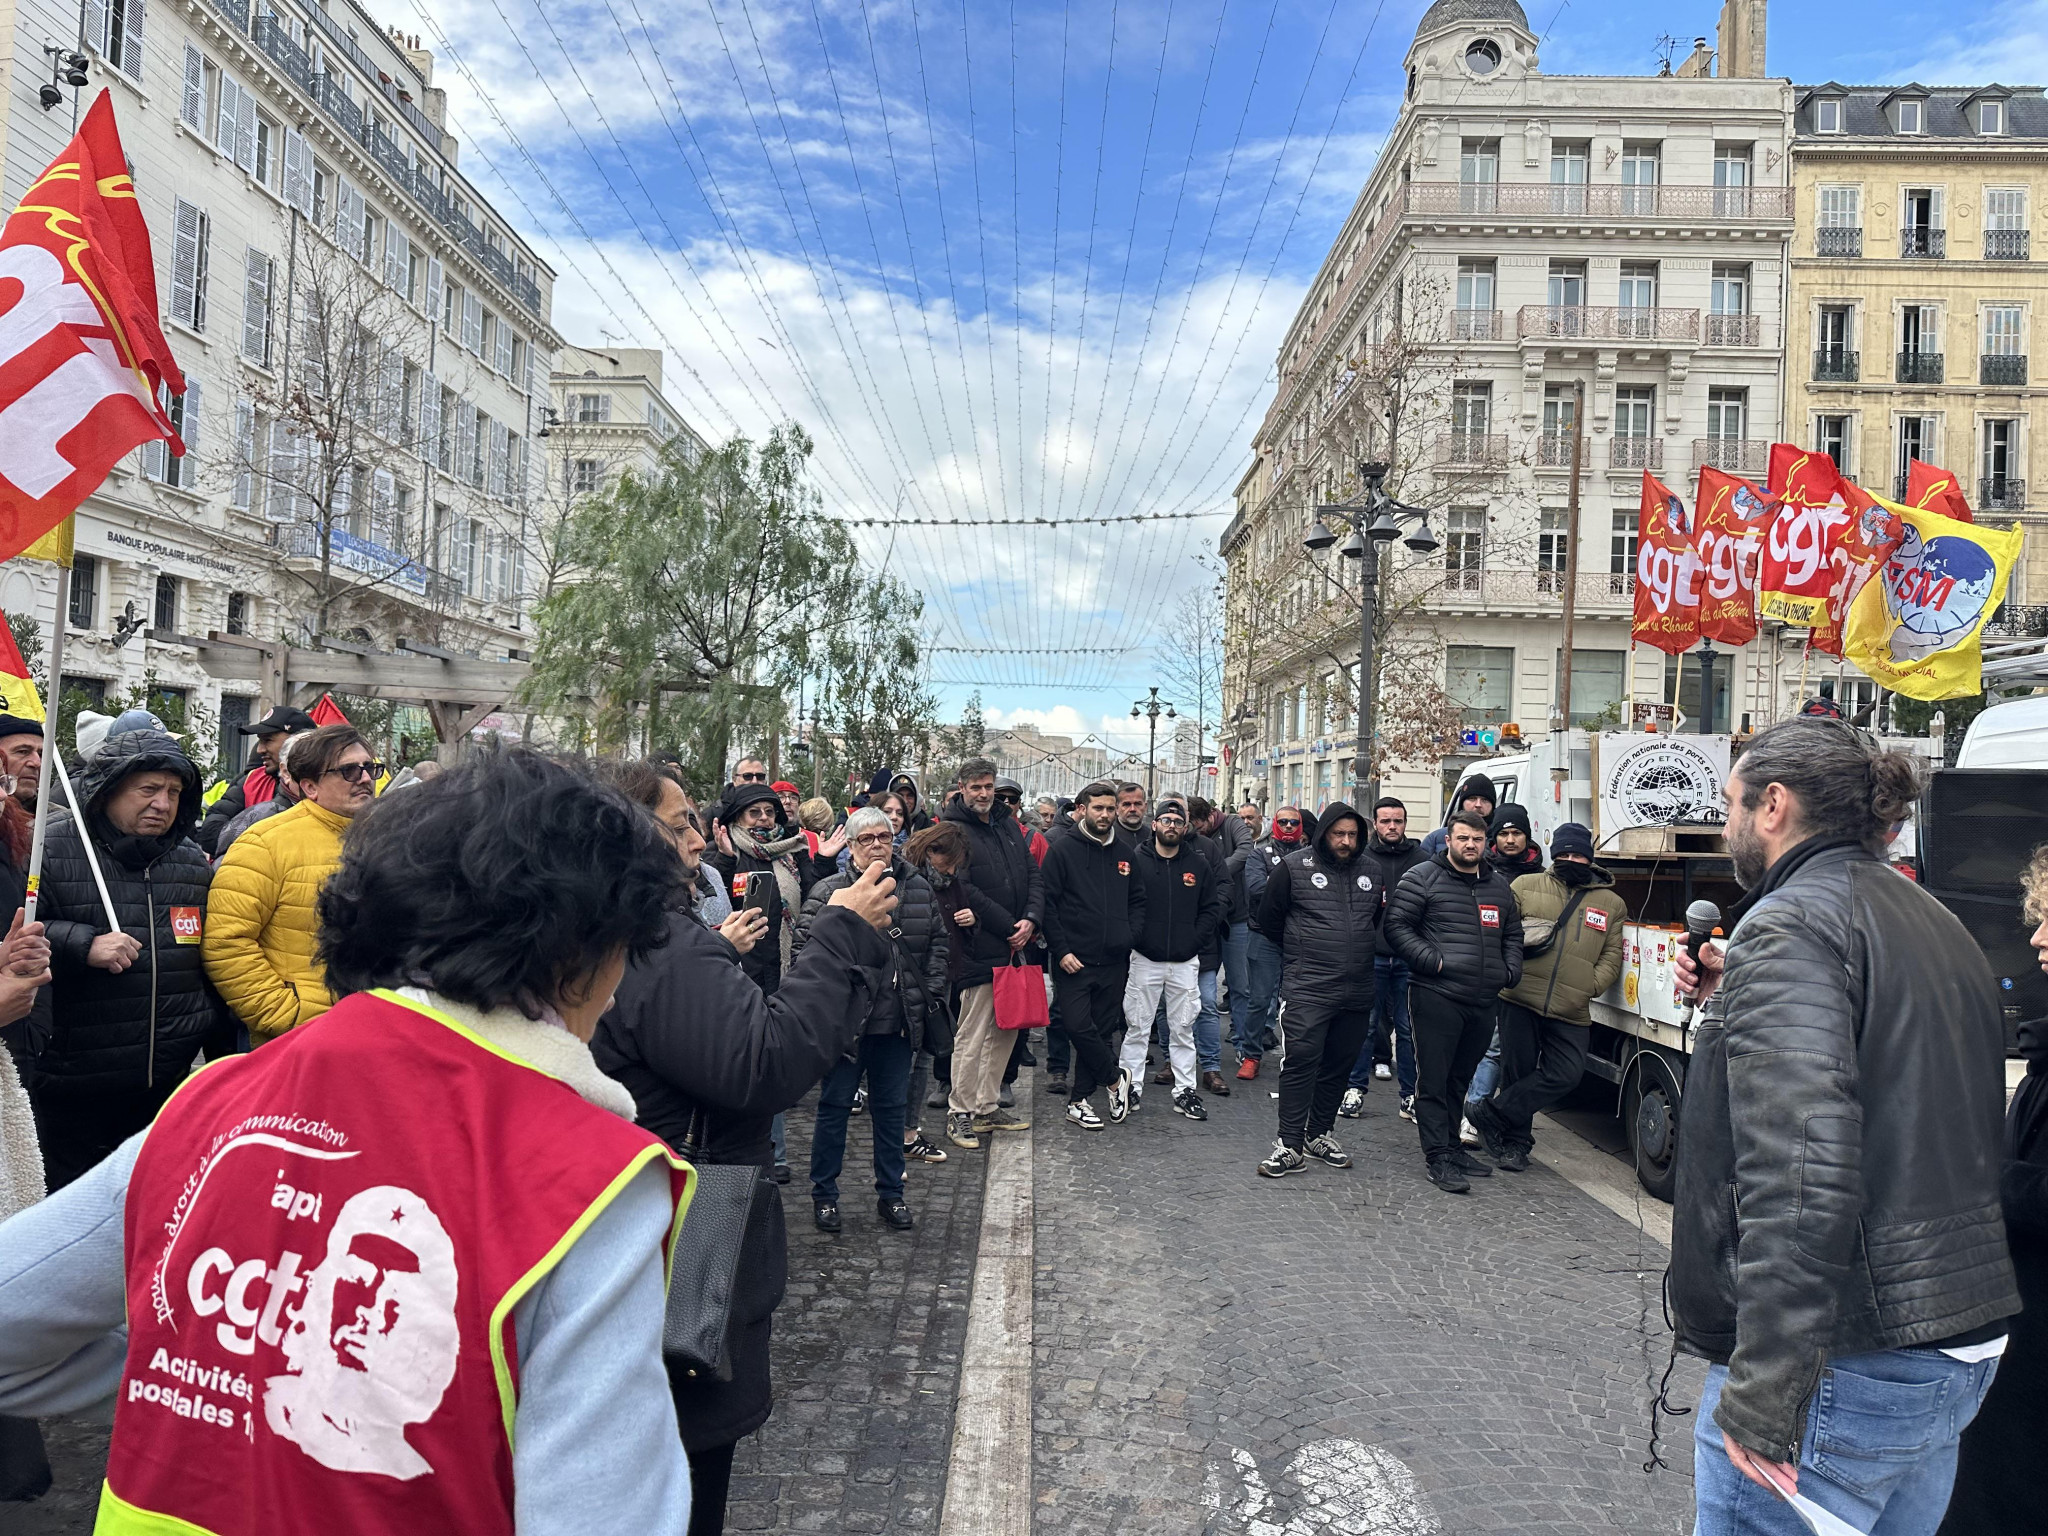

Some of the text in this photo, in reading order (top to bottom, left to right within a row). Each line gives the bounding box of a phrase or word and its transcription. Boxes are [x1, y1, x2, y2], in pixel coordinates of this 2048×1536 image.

[107, 531, 142, 549] BANQUE
[143, 541, 186, 560] POPULAIRE
[1698, 527, 1762, 599] cgt
[1638, 539, 1705, 613] cgt
[1661, 616, 1695, 633] Rhône
[1609, 758, 1631, 799] Fédération
[1632, 742, 1666, 759] nationale
[1670, 742, 1684, 752] des
[1685, 749, 1706, 765] ports
[1704, 766, 1713, 775] et
[1710, 777, 1719, 800] docks
[175, 915, 199, 935] cgt
[164, 1171, 198, 1236] droit
[187, 1247, 303, 1356] cgt
[128, 1378, 235, 1428] postales
